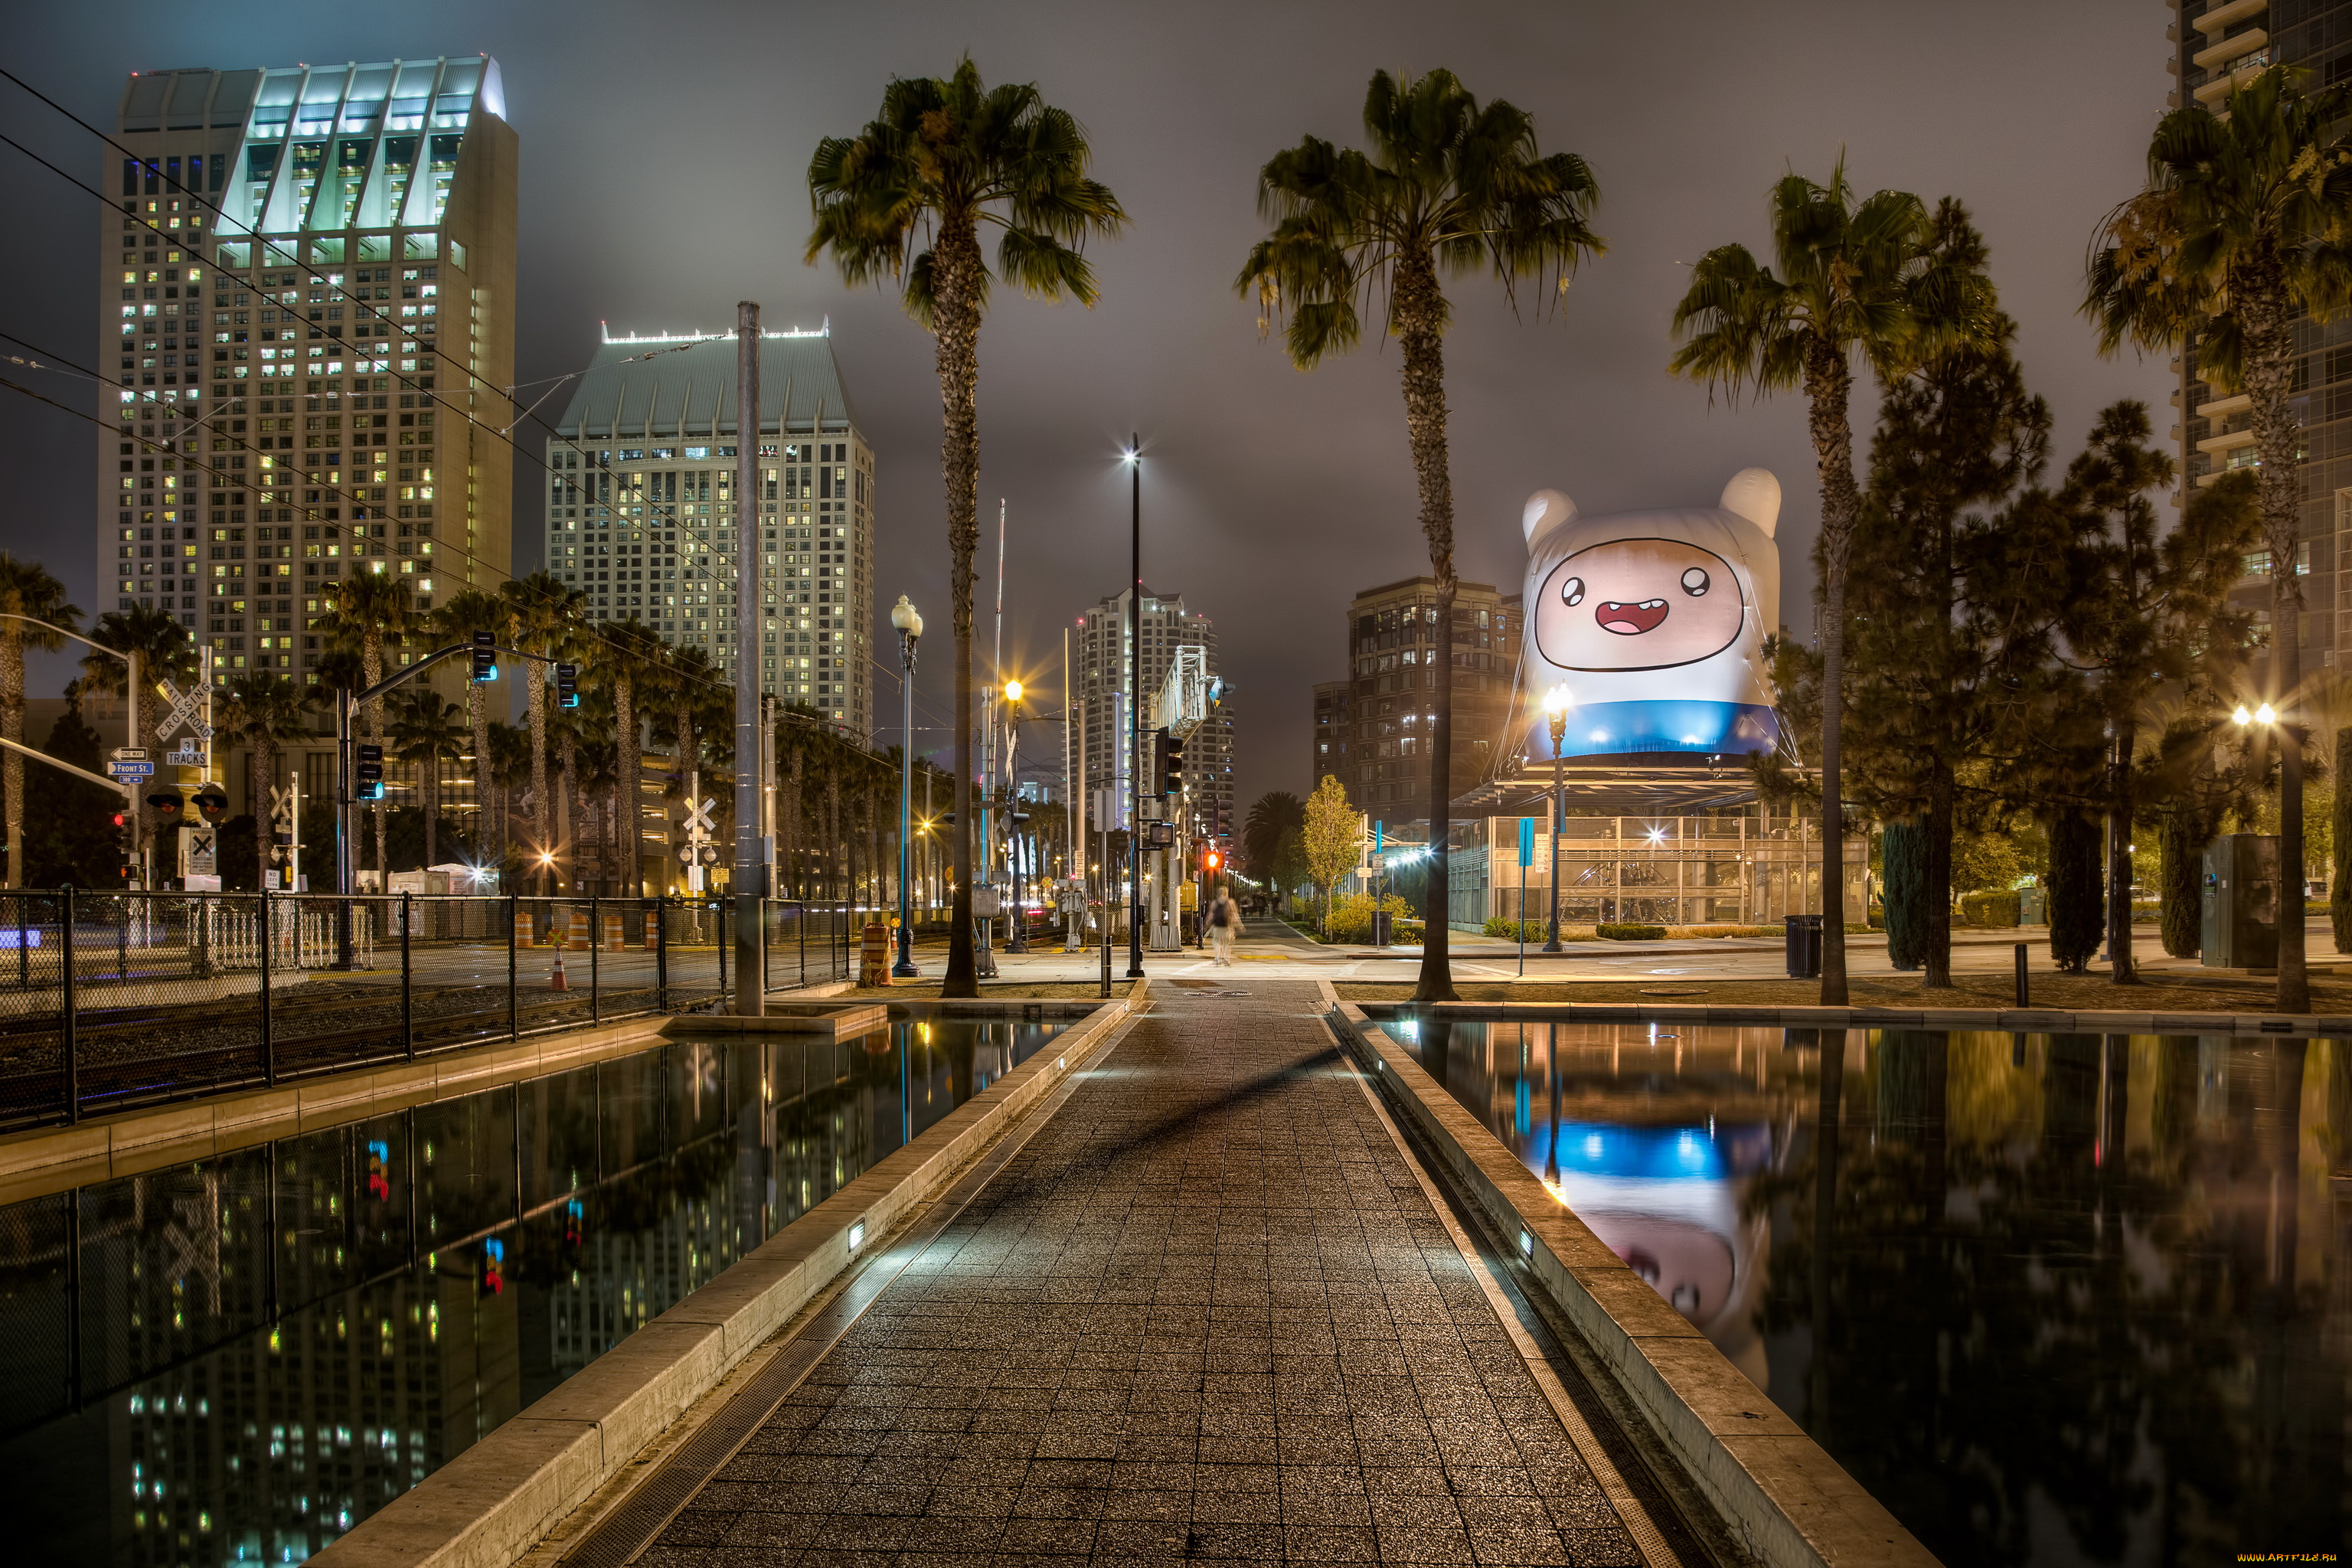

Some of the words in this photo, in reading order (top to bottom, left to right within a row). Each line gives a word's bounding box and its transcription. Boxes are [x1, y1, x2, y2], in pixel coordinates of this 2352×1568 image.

[159, 682, 211, 737] CROSSING
[184, 741, 191, 752] 3
[168, 753, 206, 764] TRACKS
[117, 764, 138, 773] FRONT
